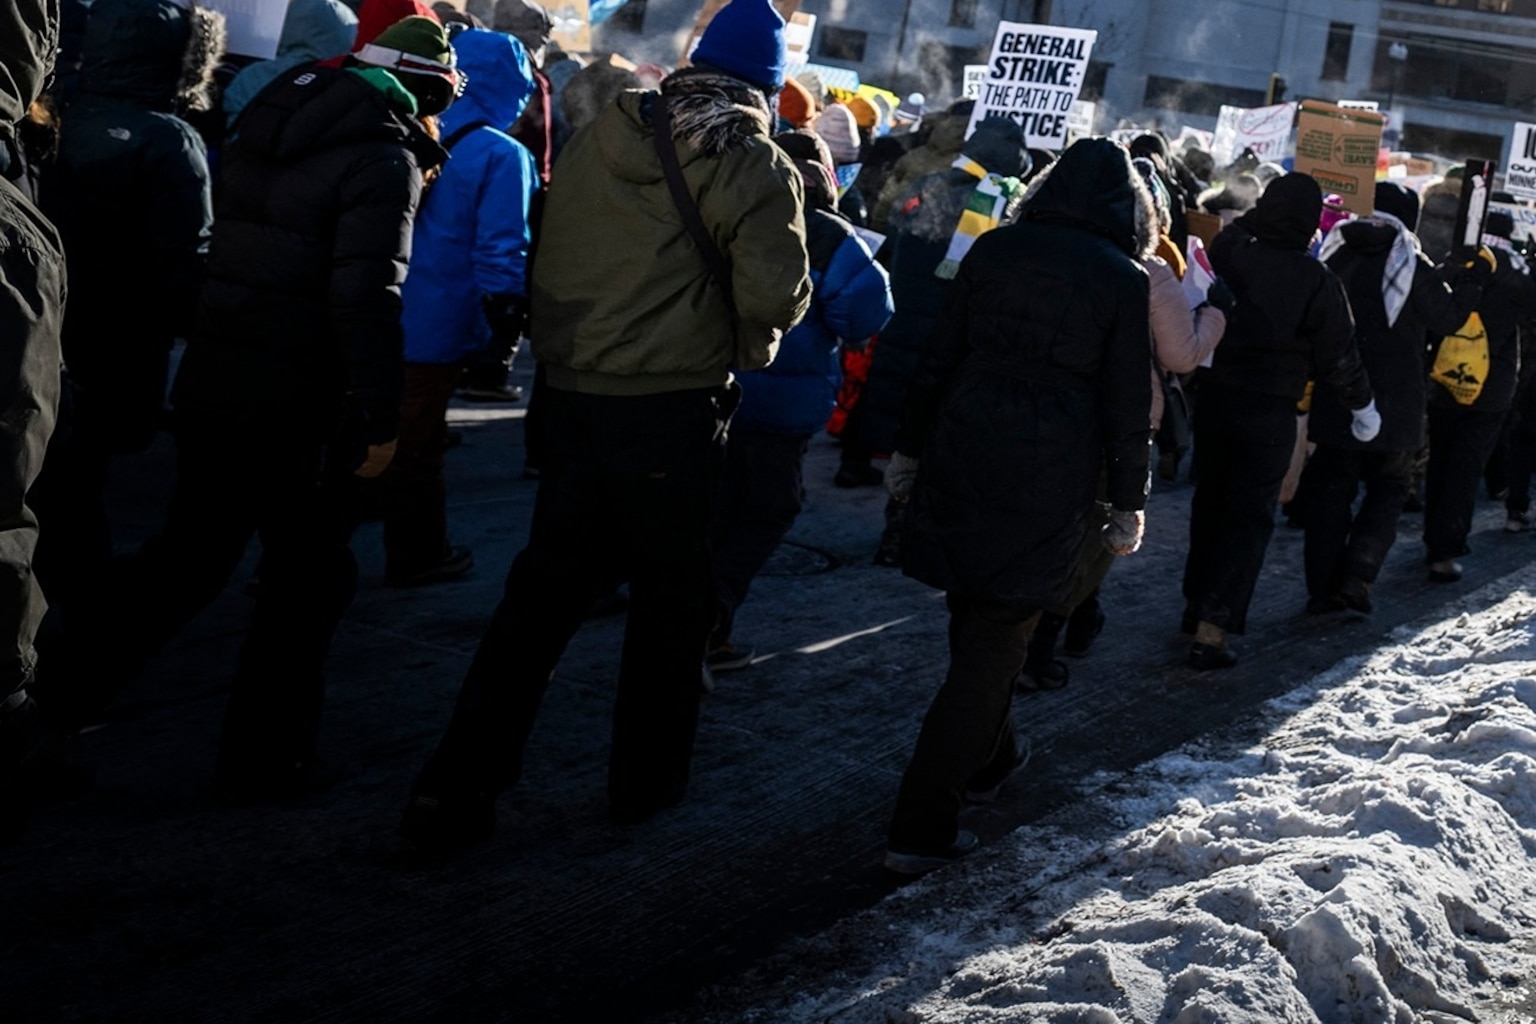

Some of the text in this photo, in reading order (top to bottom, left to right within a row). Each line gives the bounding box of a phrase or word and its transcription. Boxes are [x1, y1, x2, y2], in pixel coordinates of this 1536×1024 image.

[999, 32, 1085, 60] GENERAL
[990, 56, 1081, 88] STRIKE:
[984, 83, 1013, 107] THE
[1012, 86, 1052, 110] PATH
[1053, 91, 1073, 112] TO
[985, 109, 1066, 138] TICE
